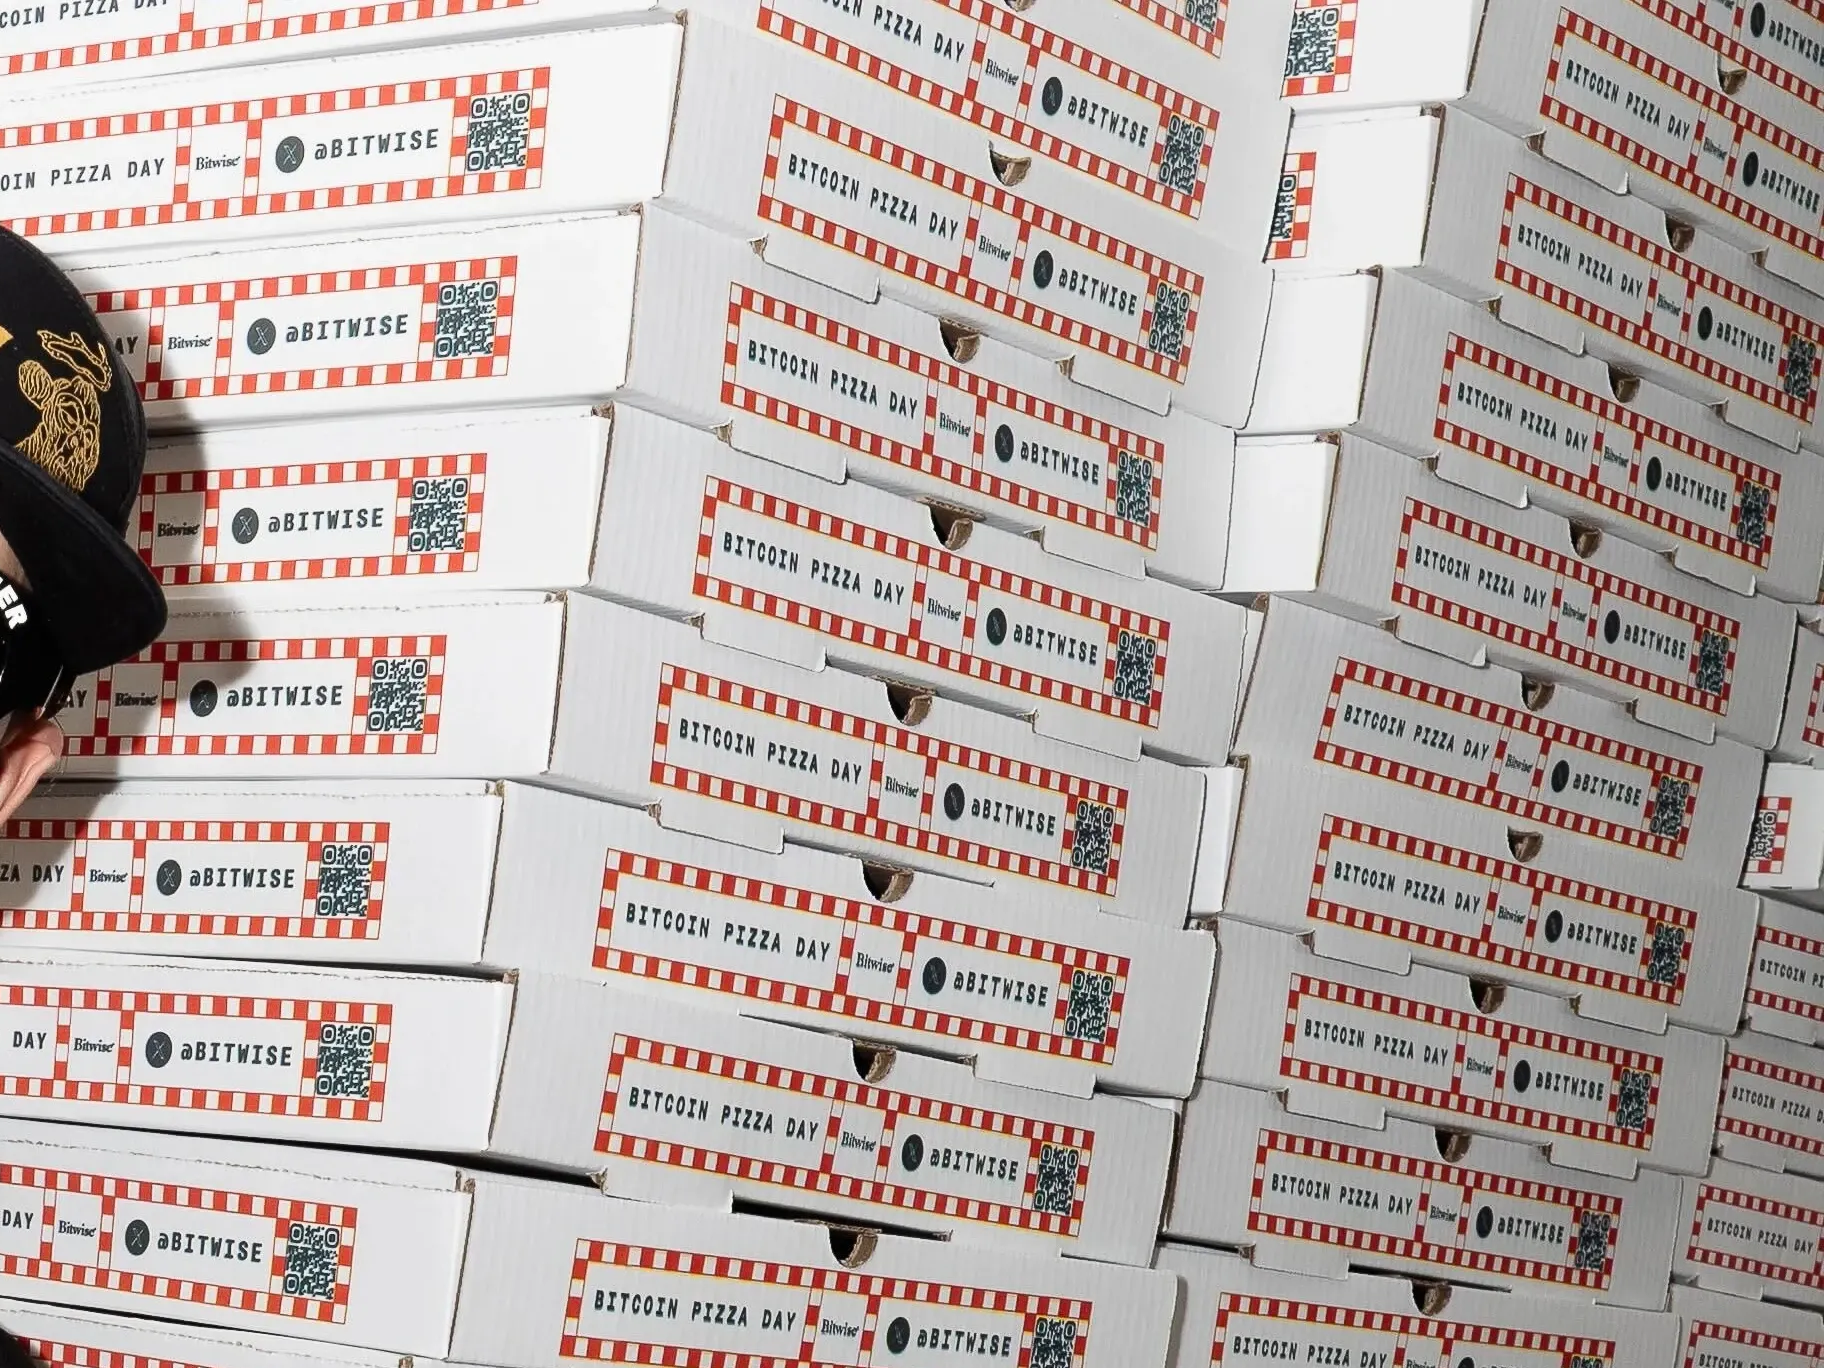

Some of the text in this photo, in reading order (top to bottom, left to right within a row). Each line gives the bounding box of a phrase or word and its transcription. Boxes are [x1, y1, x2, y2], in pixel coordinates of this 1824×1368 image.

[59, 0, 119, 20] PIZZA
[873, 4, 922, 46] PIZZA
[933, 32, 965, 63] DAY
[984, 58, 1020, 86] Bitwise
[314, 128, 439, 161] @BITWISE
[50, 163, 111, 187] PIZZA
[127, 157, 165, 178] DAY
[195, 156, 241, 171] Bitwise
[788, 153, 959, 241] BITCOIN PIZZA DAY
[978, 234, 1012, 262] Bitwise
[1517, 223, 1643, 299] BITCOIN PIZZA DAY
[285, 314, 409, 343] @BITWISE
[114, 335, 139, 356] AY
[167, 336, 213, 351] Bitwise
[748, 339, 918, 420] BITCOIN PIZZA DAY
[939, 411, 972, 438] Bitwise
[268, 507, 384, 533] @BITWISE
[723, 531, 905, 606] BITCOIN PIZZA DAY
[1415, 545, 1547, 609] BITCOIN PIZZA DAY
[927, 597, 962, 622] Bitwise
[226, 685, 343, 708] @BITWISE
[679, 717, 862, 785] BITCOIN PIZZA DAY
[884, 775, 920, 798] Bitwise
[32, 864, 65, 883] DAY
[89, 868, 128, 883] Bitwise
[189, 867, 295, 889] @BITWISE
[1333, 860, 1481, 914] BITCOIN PIZZA DAY
[626, 902, 831, 962] BITCOIN PIZZA DAY
[855, 951, 895, 974] Bitwise
[12, 1030, 47, 1050] DAY
[73, 1037, 115, 1053] Bitwise
[180, 1041, 293, 1067] @BITWISE
[628, 1086, 819, 1142] BITCOIN PIZZA DAY
[840, 1130, 877, 1153] Bitwise
[1271, 1173, 1413, 1216] BITCOIN PIZZA DAY
[2, 1209, 34, 1230] DAY
[58, 1220, 97, 1238] Bitwise
[157, 1231, 263, 1263] @BITWISE
[594, 1289, 797, 1332] BITCOIN PIZZA DAY
[820, 1318, 860, 1338] Bitwise
